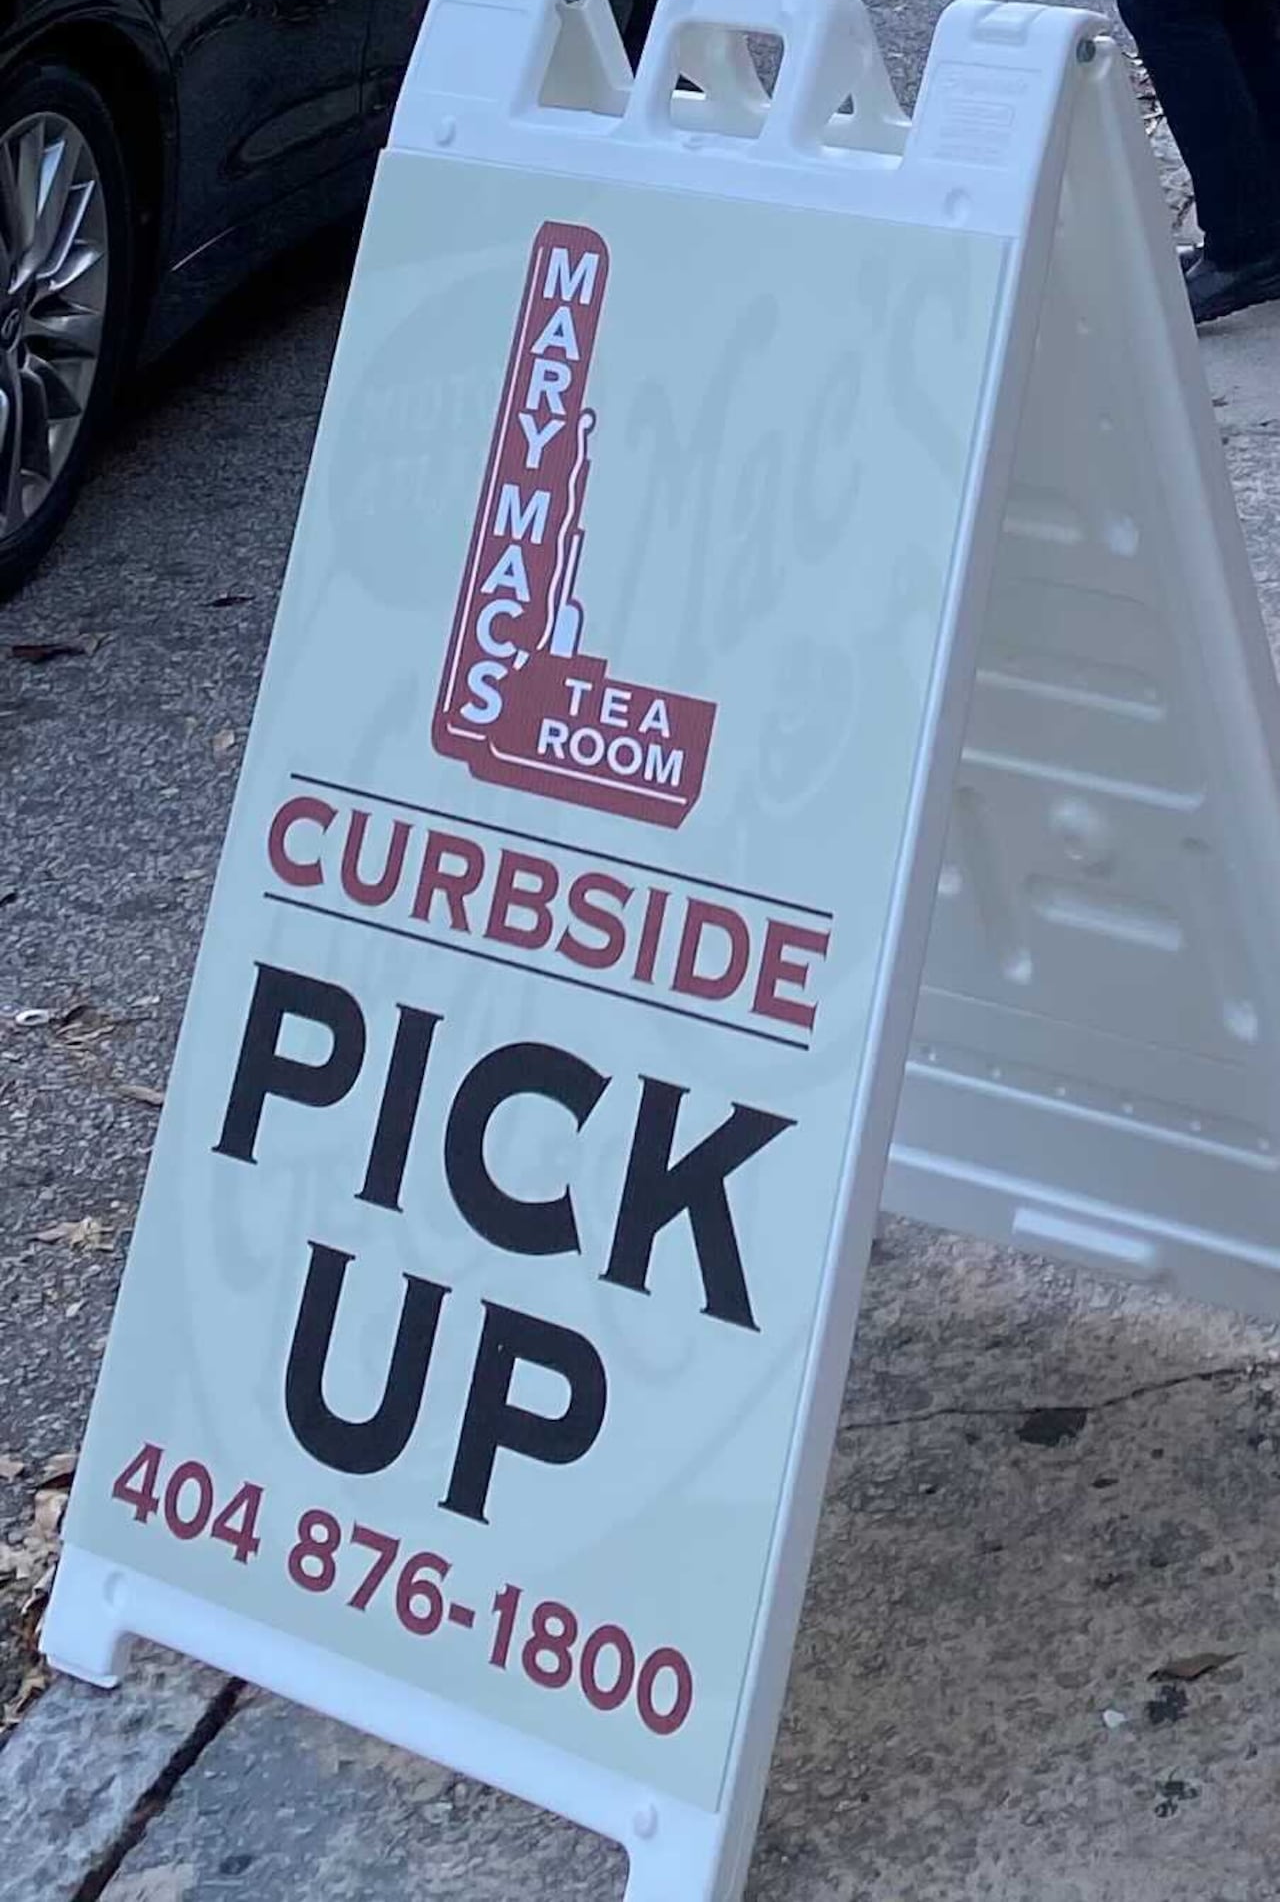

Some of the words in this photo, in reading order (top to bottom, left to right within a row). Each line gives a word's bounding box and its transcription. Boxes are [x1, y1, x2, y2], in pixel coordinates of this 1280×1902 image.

[517, 246, 600, 470] MARY
[459, 482, 552, 725] MAC'S
[563, 676, 673, 739] TEA
[536, 718, 686, 788] ROOM
[266, 796, 833, 1031] CURBSIDE
[211, 960, 798, 1333] PICK
[283, 1239, 610, 1527] UP
[111, 1442, 265, 1565] 404
[287, 1507, 694, 1737] 876-1800
